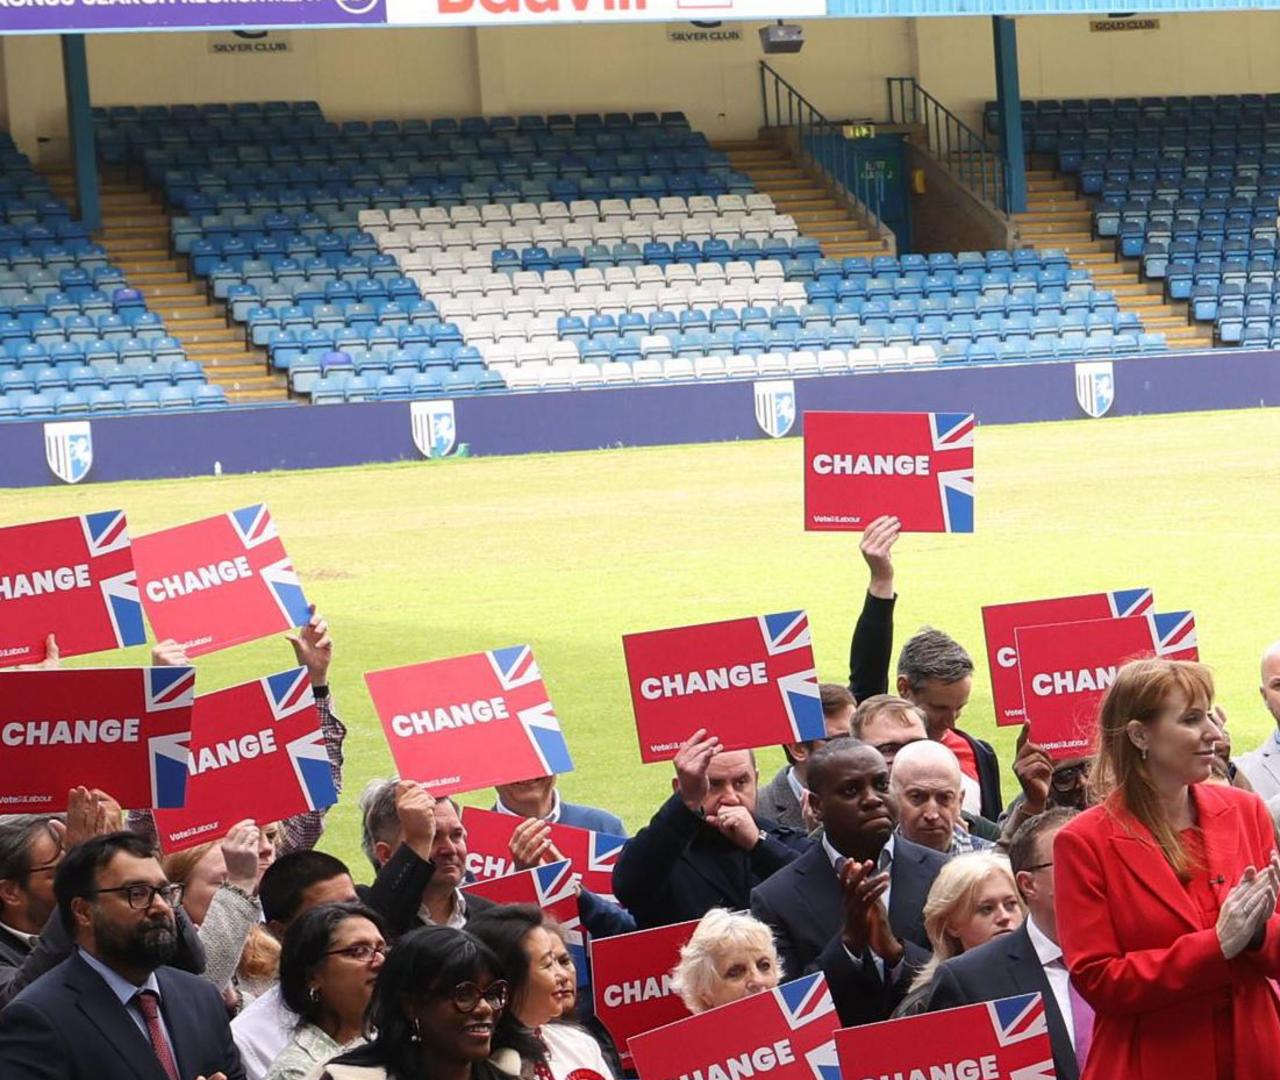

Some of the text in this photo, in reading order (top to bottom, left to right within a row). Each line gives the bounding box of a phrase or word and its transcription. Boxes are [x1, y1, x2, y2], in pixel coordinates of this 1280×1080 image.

[213, 42, 287, 52] SILVER CLUB
[671, 31, 708, 41] SILVER
[813, 453, 930, 476] CHANGE
[0, 563, 92, 600] HANGE
[146, 555, 253, 602] CHANGE
[640, 662, 769, 700] CHANGE
[1032, 665, 1118, 696] CHAN
[391, 696, 510, 737] CHANGE
[1, 718, 140, 746] CHANGE
[169, 829, 187, 842] Vote
